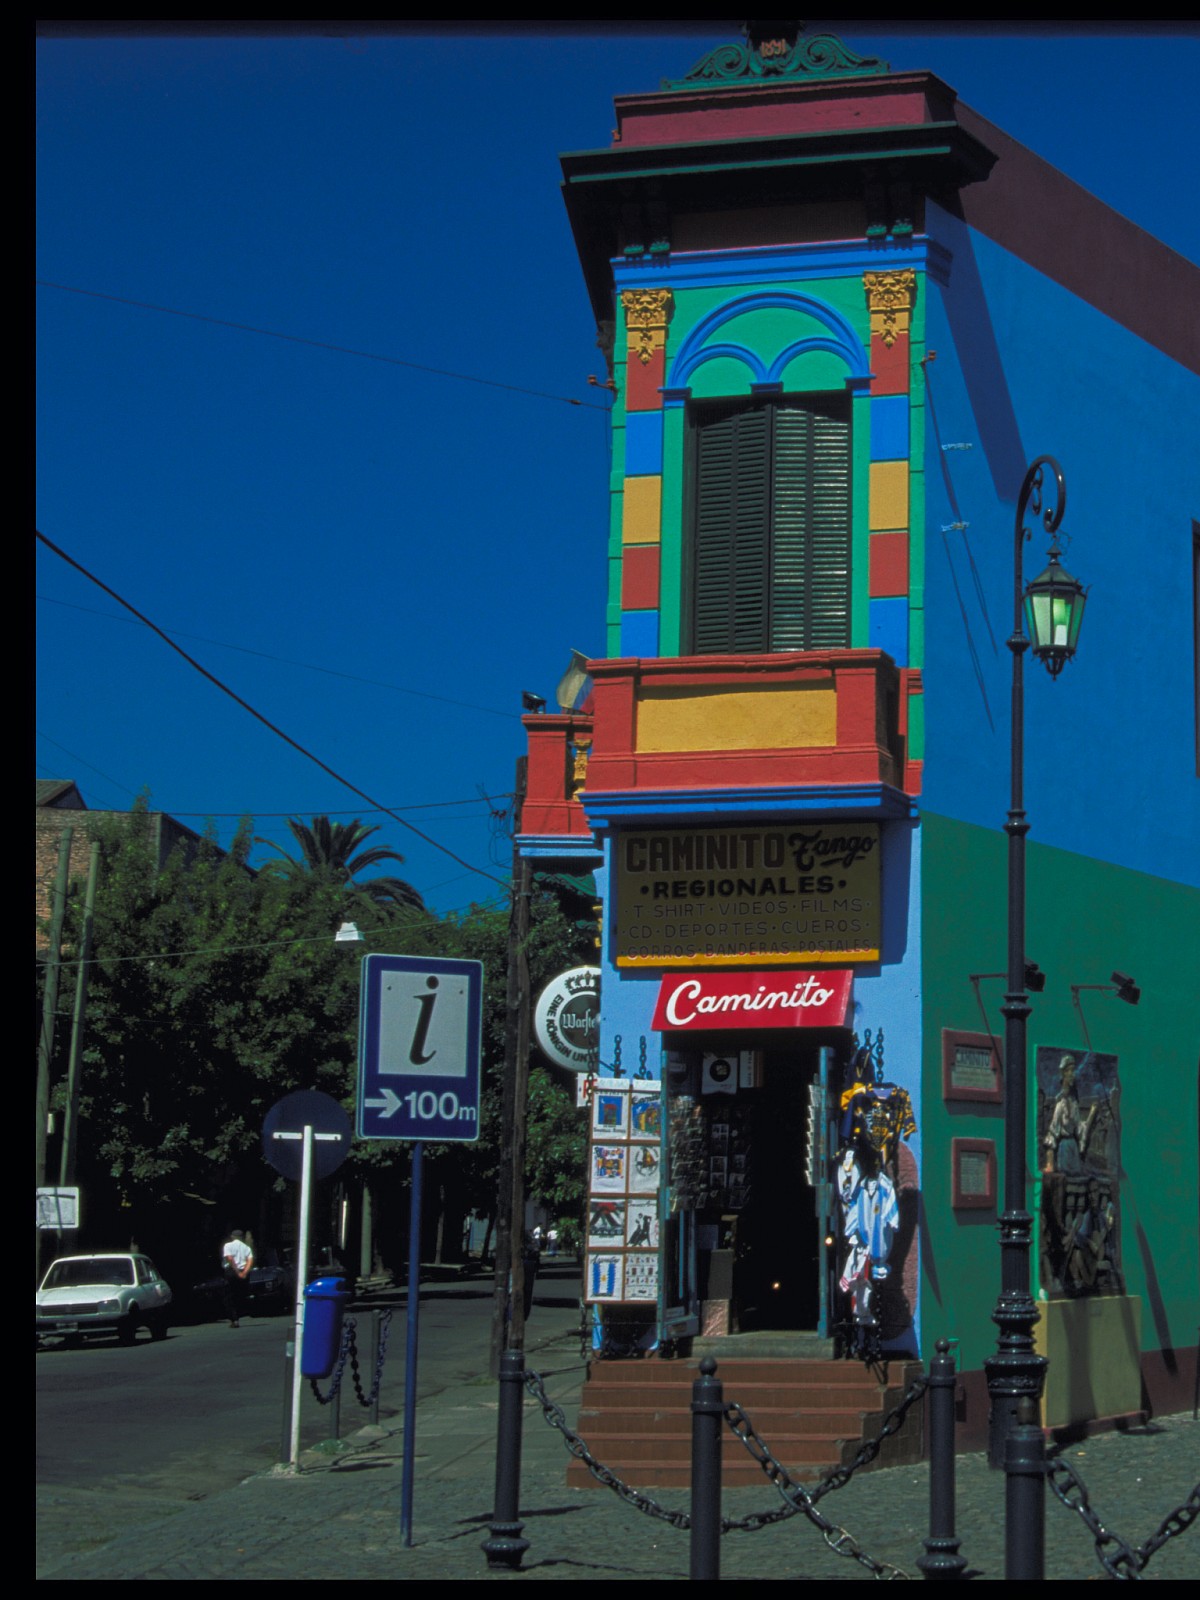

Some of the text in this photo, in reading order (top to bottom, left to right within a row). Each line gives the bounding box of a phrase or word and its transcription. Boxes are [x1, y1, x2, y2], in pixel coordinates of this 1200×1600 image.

[625, 830, 877, 873] CAMINITO Tango
[653, 876, 834, 899] REGIONALES
[653, 903, 706, 917] SHIRT
[719, 901, 788, 916] VIDEOS
[801, 898, 862, 913] FILMS
[629, 919, 861, 939] CD DEPORTES CUEROS
[627, 939, 871, 960] GORROS BANDERAS POSTALES
[546, 994, 565, 1017] EINE
[666, 975, 834, 1026] Caminito
[409, 975, 439, 1065] i
